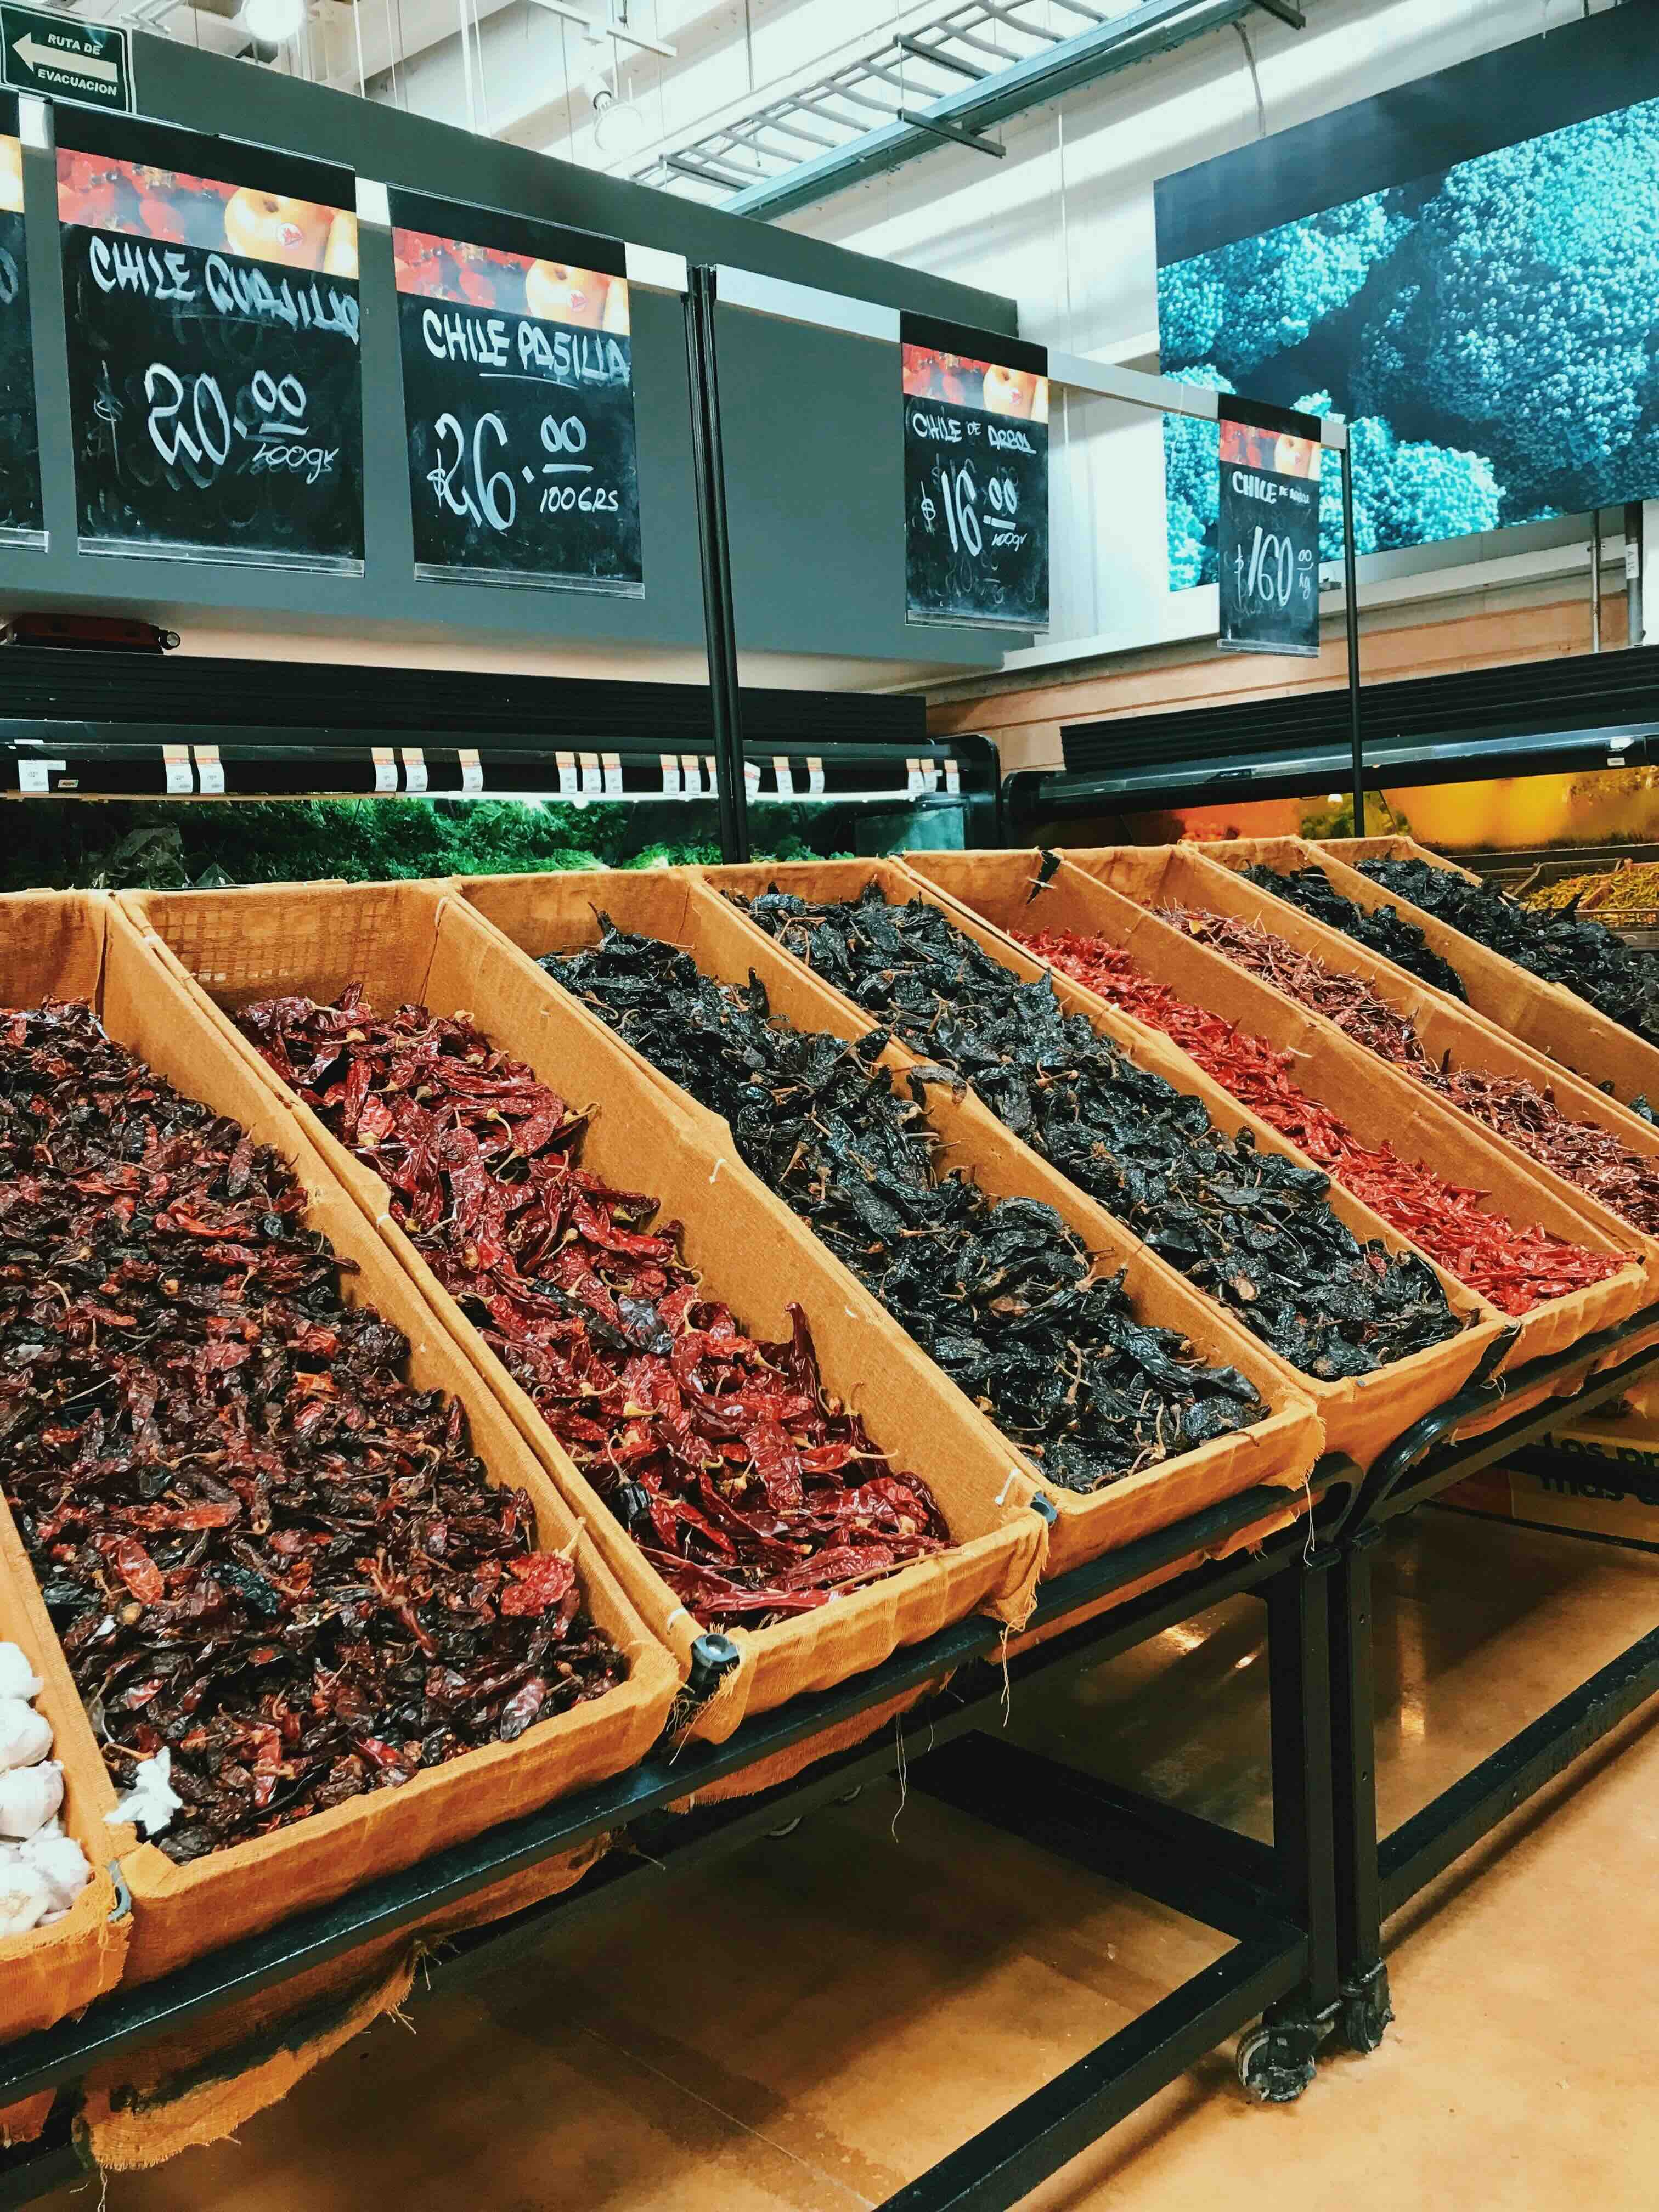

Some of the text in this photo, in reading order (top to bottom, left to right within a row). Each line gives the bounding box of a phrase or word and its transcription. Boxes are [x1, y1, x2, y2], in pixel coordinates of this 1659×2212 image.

[48, 33, 101, 55] RUTA DE
[38, 69, 117, 96] EVACUACION
[89, 236, 195, 302] CHILE
[422, 308, 630, 387] CHILE PASILLA
[912, 413, 962, 443] CHILE
[966, 421, 981, 435] DE
[539, 486, 619, 513] 100GRS
[1232, 471, 1278, 504] CHILE
